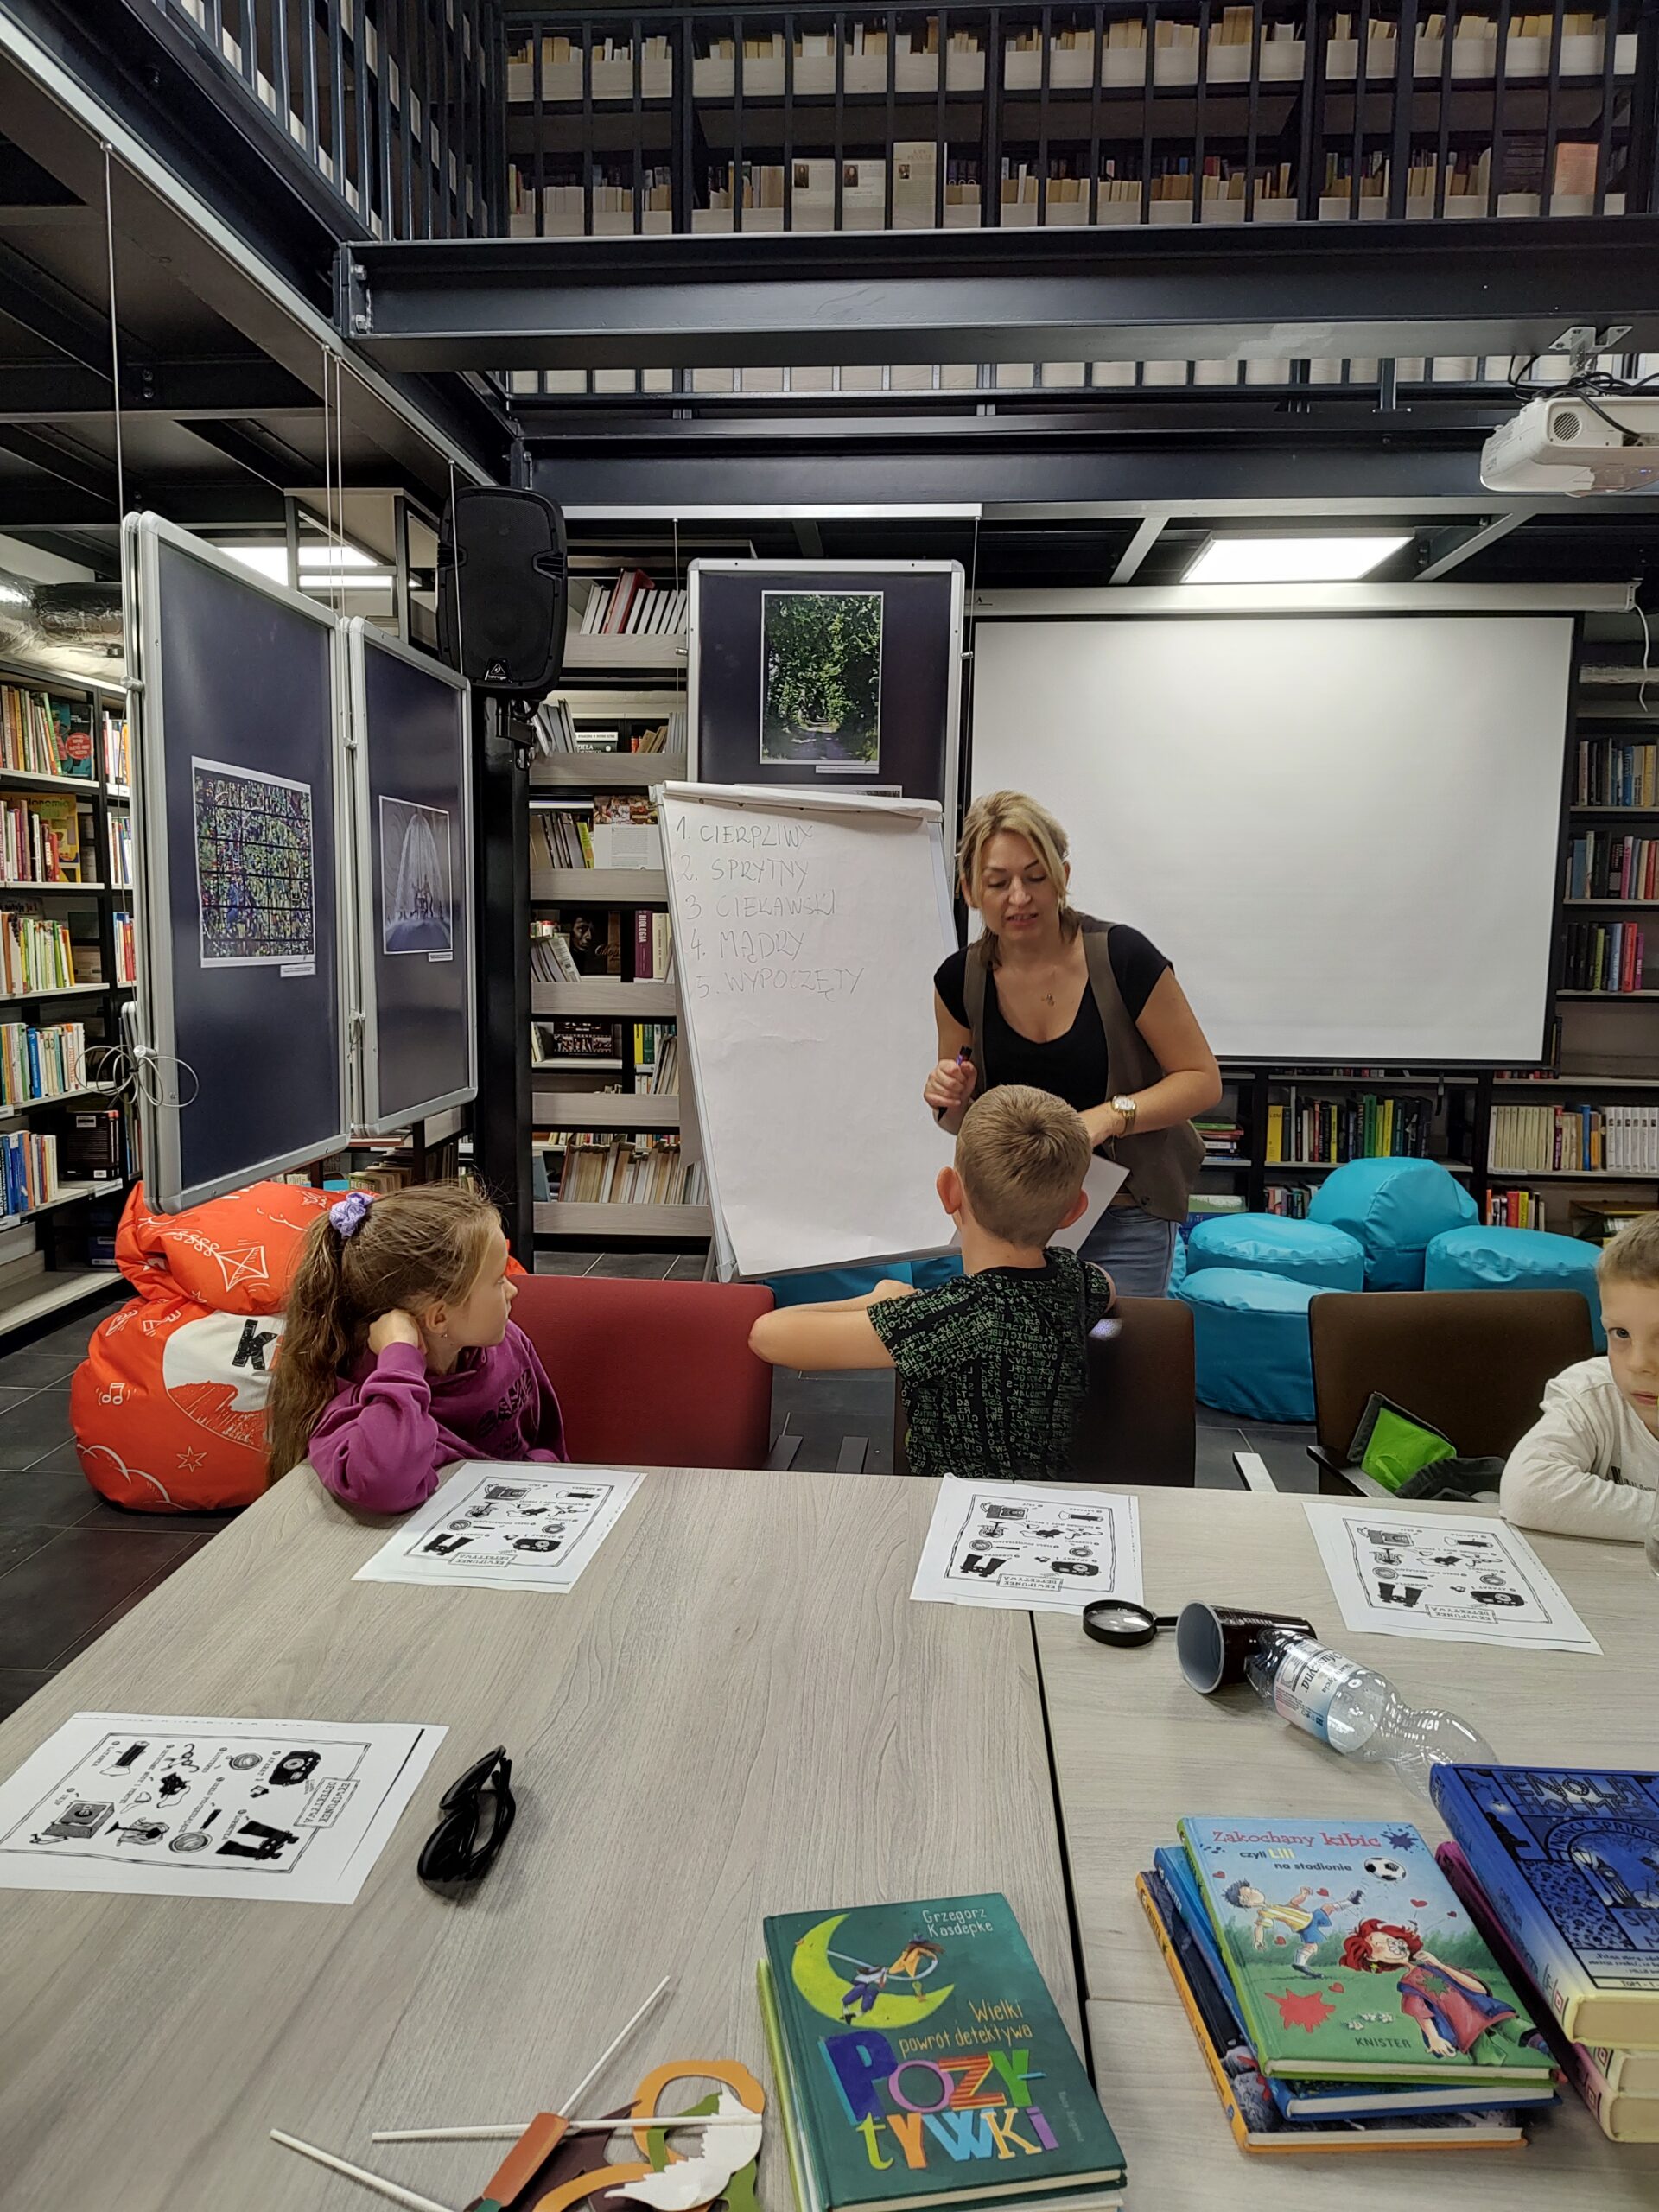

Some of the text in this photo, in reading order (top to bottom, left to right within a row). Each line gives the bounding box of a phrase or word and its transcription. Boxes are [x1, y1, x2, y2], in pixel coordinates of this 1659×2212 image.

[676, 816, 813, 848] 1. CIERPLIWY
[677, 855, 809, 893] 2. SPRYTNY
[716, 889, 836, 918] CIEKAWSKI
[639, 914, 647, 943] BIOLOGIA
[691, 928, 707, 961] 4.
[720, 929, 805, 963] MĄDRY
[696, 967, 865, 1002] 5. WYPOCZĘTY
[1502, 1773, 1643, 1803] ENOLA
[301, 1781, 339, 1824] DETEKTYWA
[315, 1782, 352, 1823] EKWIPUNEK
[1519, 1796, 1656, 1817] HOLMES
[1212, 1831, 1382, 1847] Zakochany kibic
[1550, 1821, 1588, 1848] NANCY
[1239, 1850, 1267, 1859] czyli
[1294, 1862, 1353, 1872] stadionie
[922, 1908, 987, 1925] Grzegorz
[927, 1920, 994, 1938] Kasdepke
[968, 1999, 1024, 2024] Wielki
[954, 2021, 1033, 2048] detektywa
[1354, 2037, 1412, 2049] KNISTER
